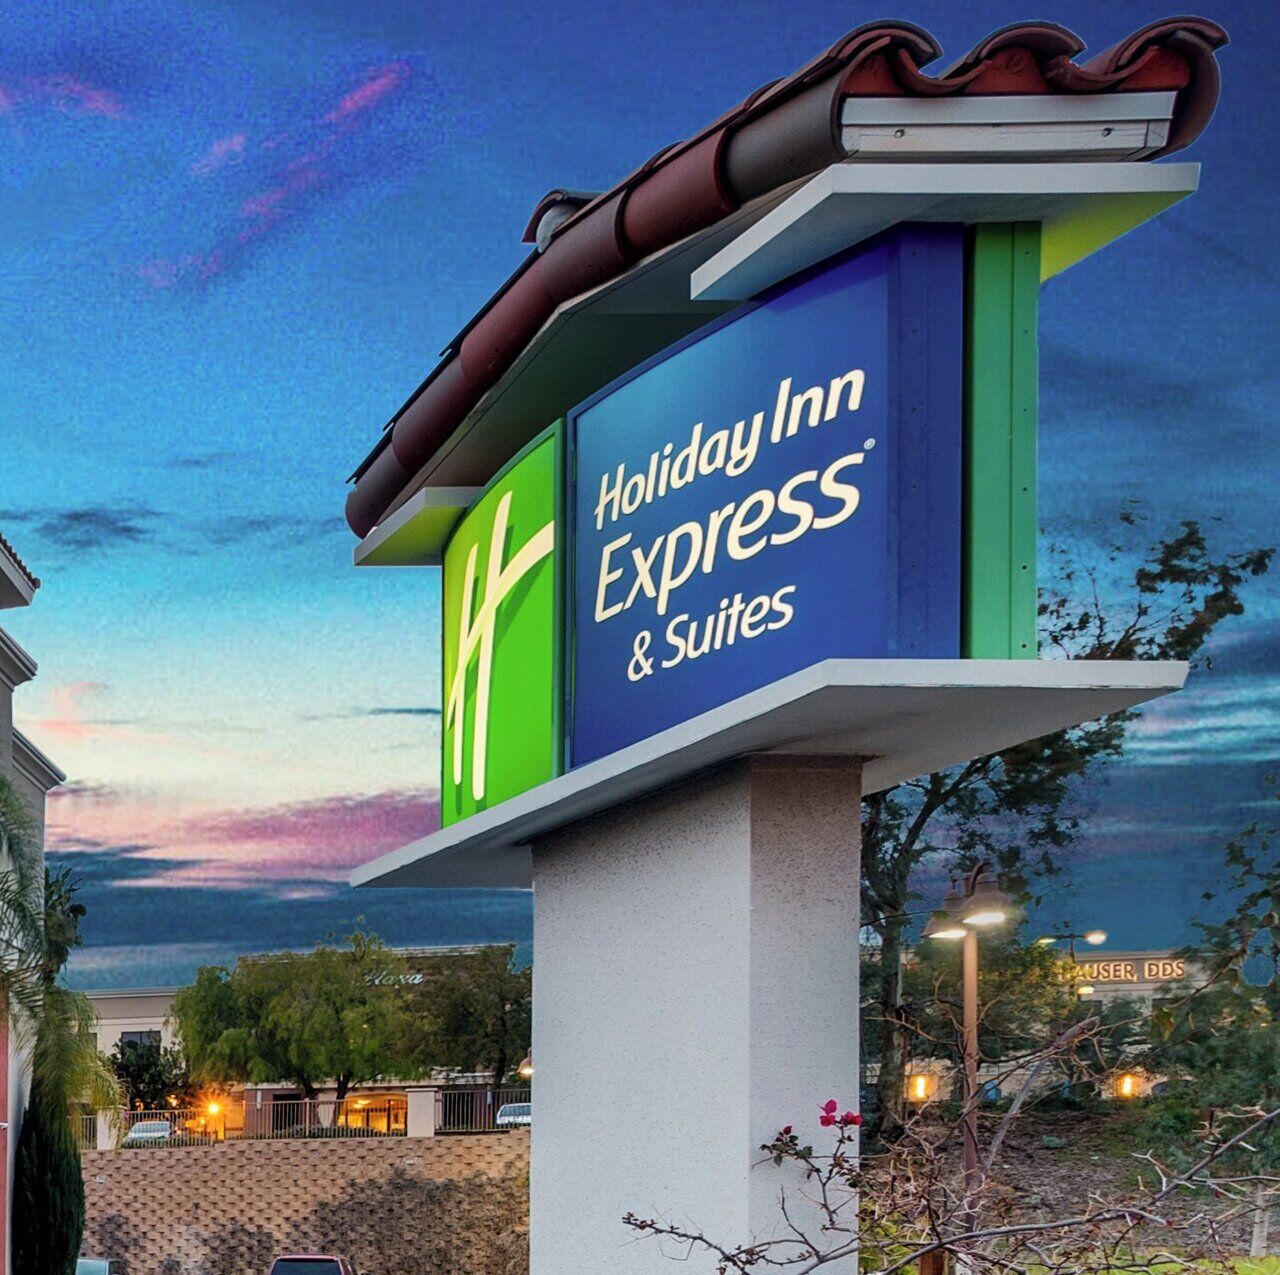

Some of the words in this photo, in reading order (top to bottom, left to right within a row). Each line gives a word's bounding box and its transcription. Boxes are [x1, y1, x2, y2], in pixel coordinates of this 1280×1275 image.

[594, 411, 765, 531] Holiday
[770, 368, 866, 444] Inn
[594, 451, 866, 624] Express
[626, 629, 655, 682] &
[661, 585, 797, 669] Suites
[1058, 961, 1138, 982] AUSER,
[1144, 960, 1186, 979] DDS
